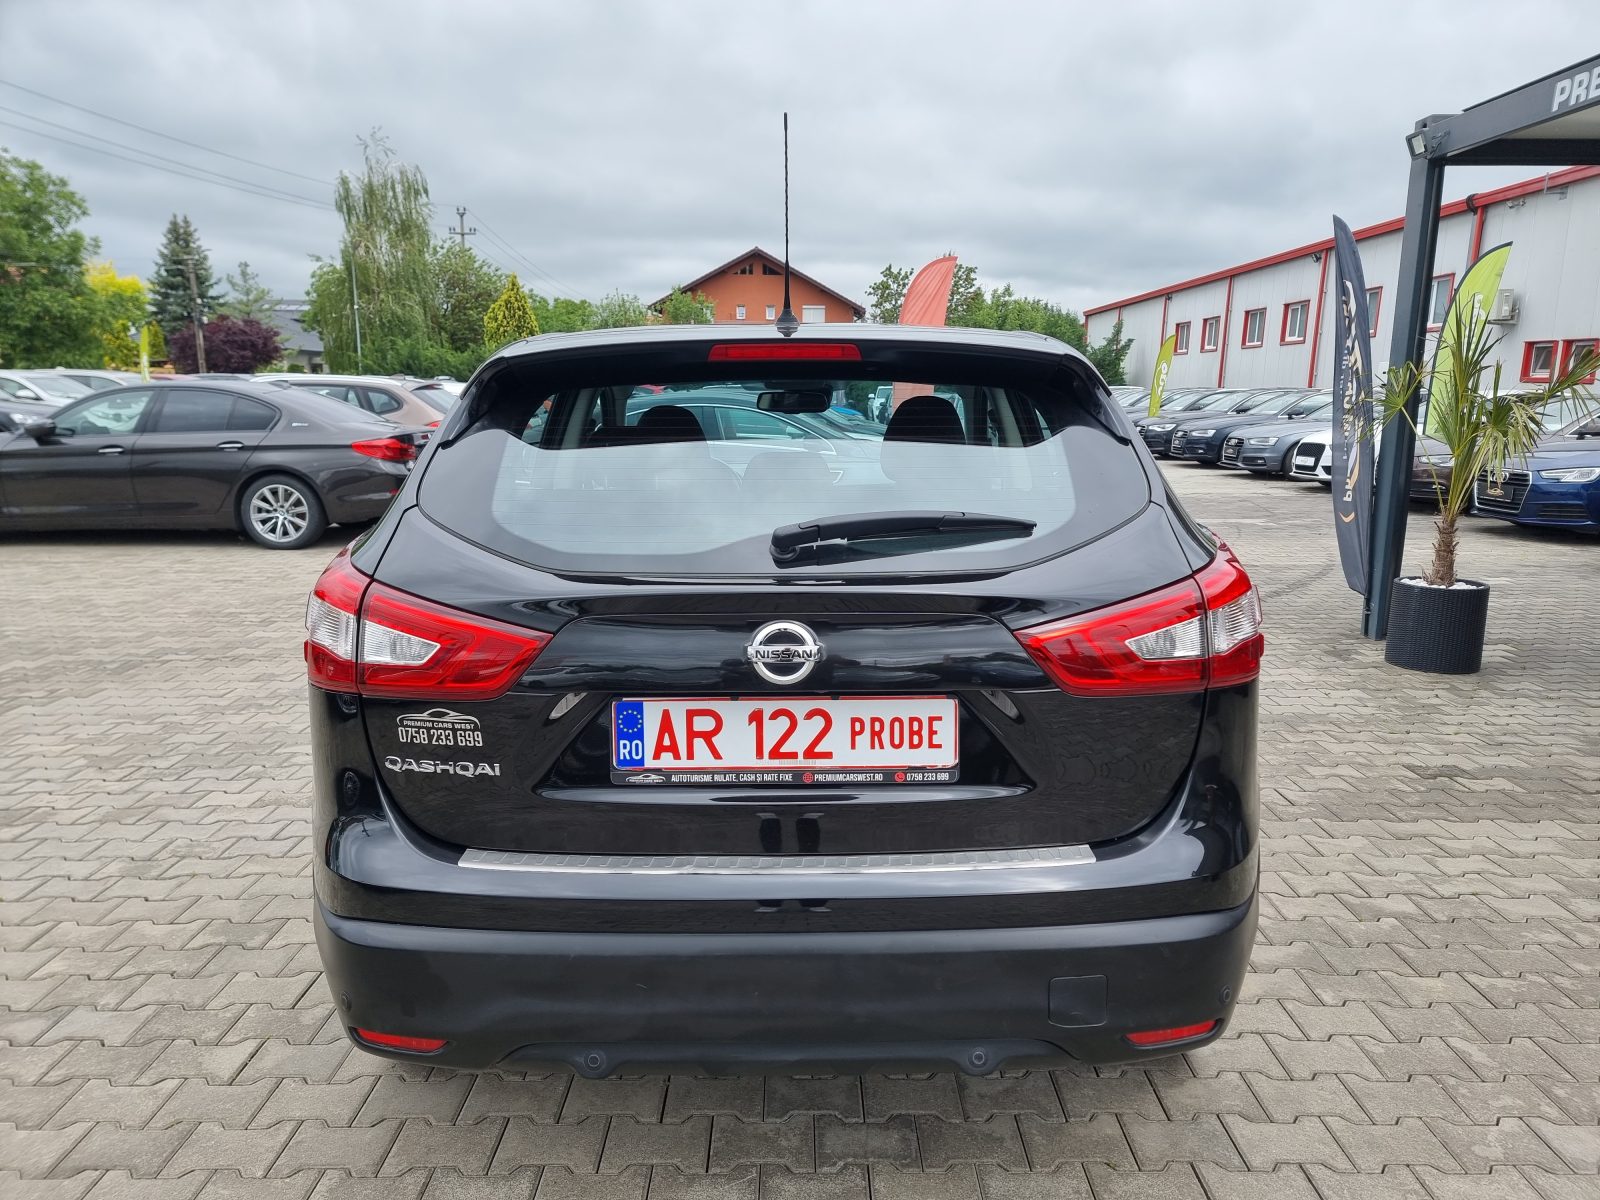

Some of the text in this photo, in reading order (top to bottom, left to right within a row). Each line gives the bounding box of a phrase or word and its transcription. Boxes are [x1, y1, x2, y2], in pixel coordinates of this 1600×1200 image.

[754, 648, 813, 659] NISSAN
[403, 720, 433, 728] PREMIUM
[398, 727, 483, 747] 0758 233 699
[652, 708, 943, 761] AR 122 PROBE
[619, 740, 643, 760] RO
[384, 755, 501, 778] QASHQAI
[671, 774, 713, 783] AUTOTURISME
[714, 773, 739, 783] RULATE,
[740, 773, 755, 782] CASH
[764, 773, 778, 782] RATE
[780, 773, 793, 782] FIXE
[814, 773, 883, 782] PREMIUMCARSWEST.RO
[906, 773, 949, 781] 0758 233 699
